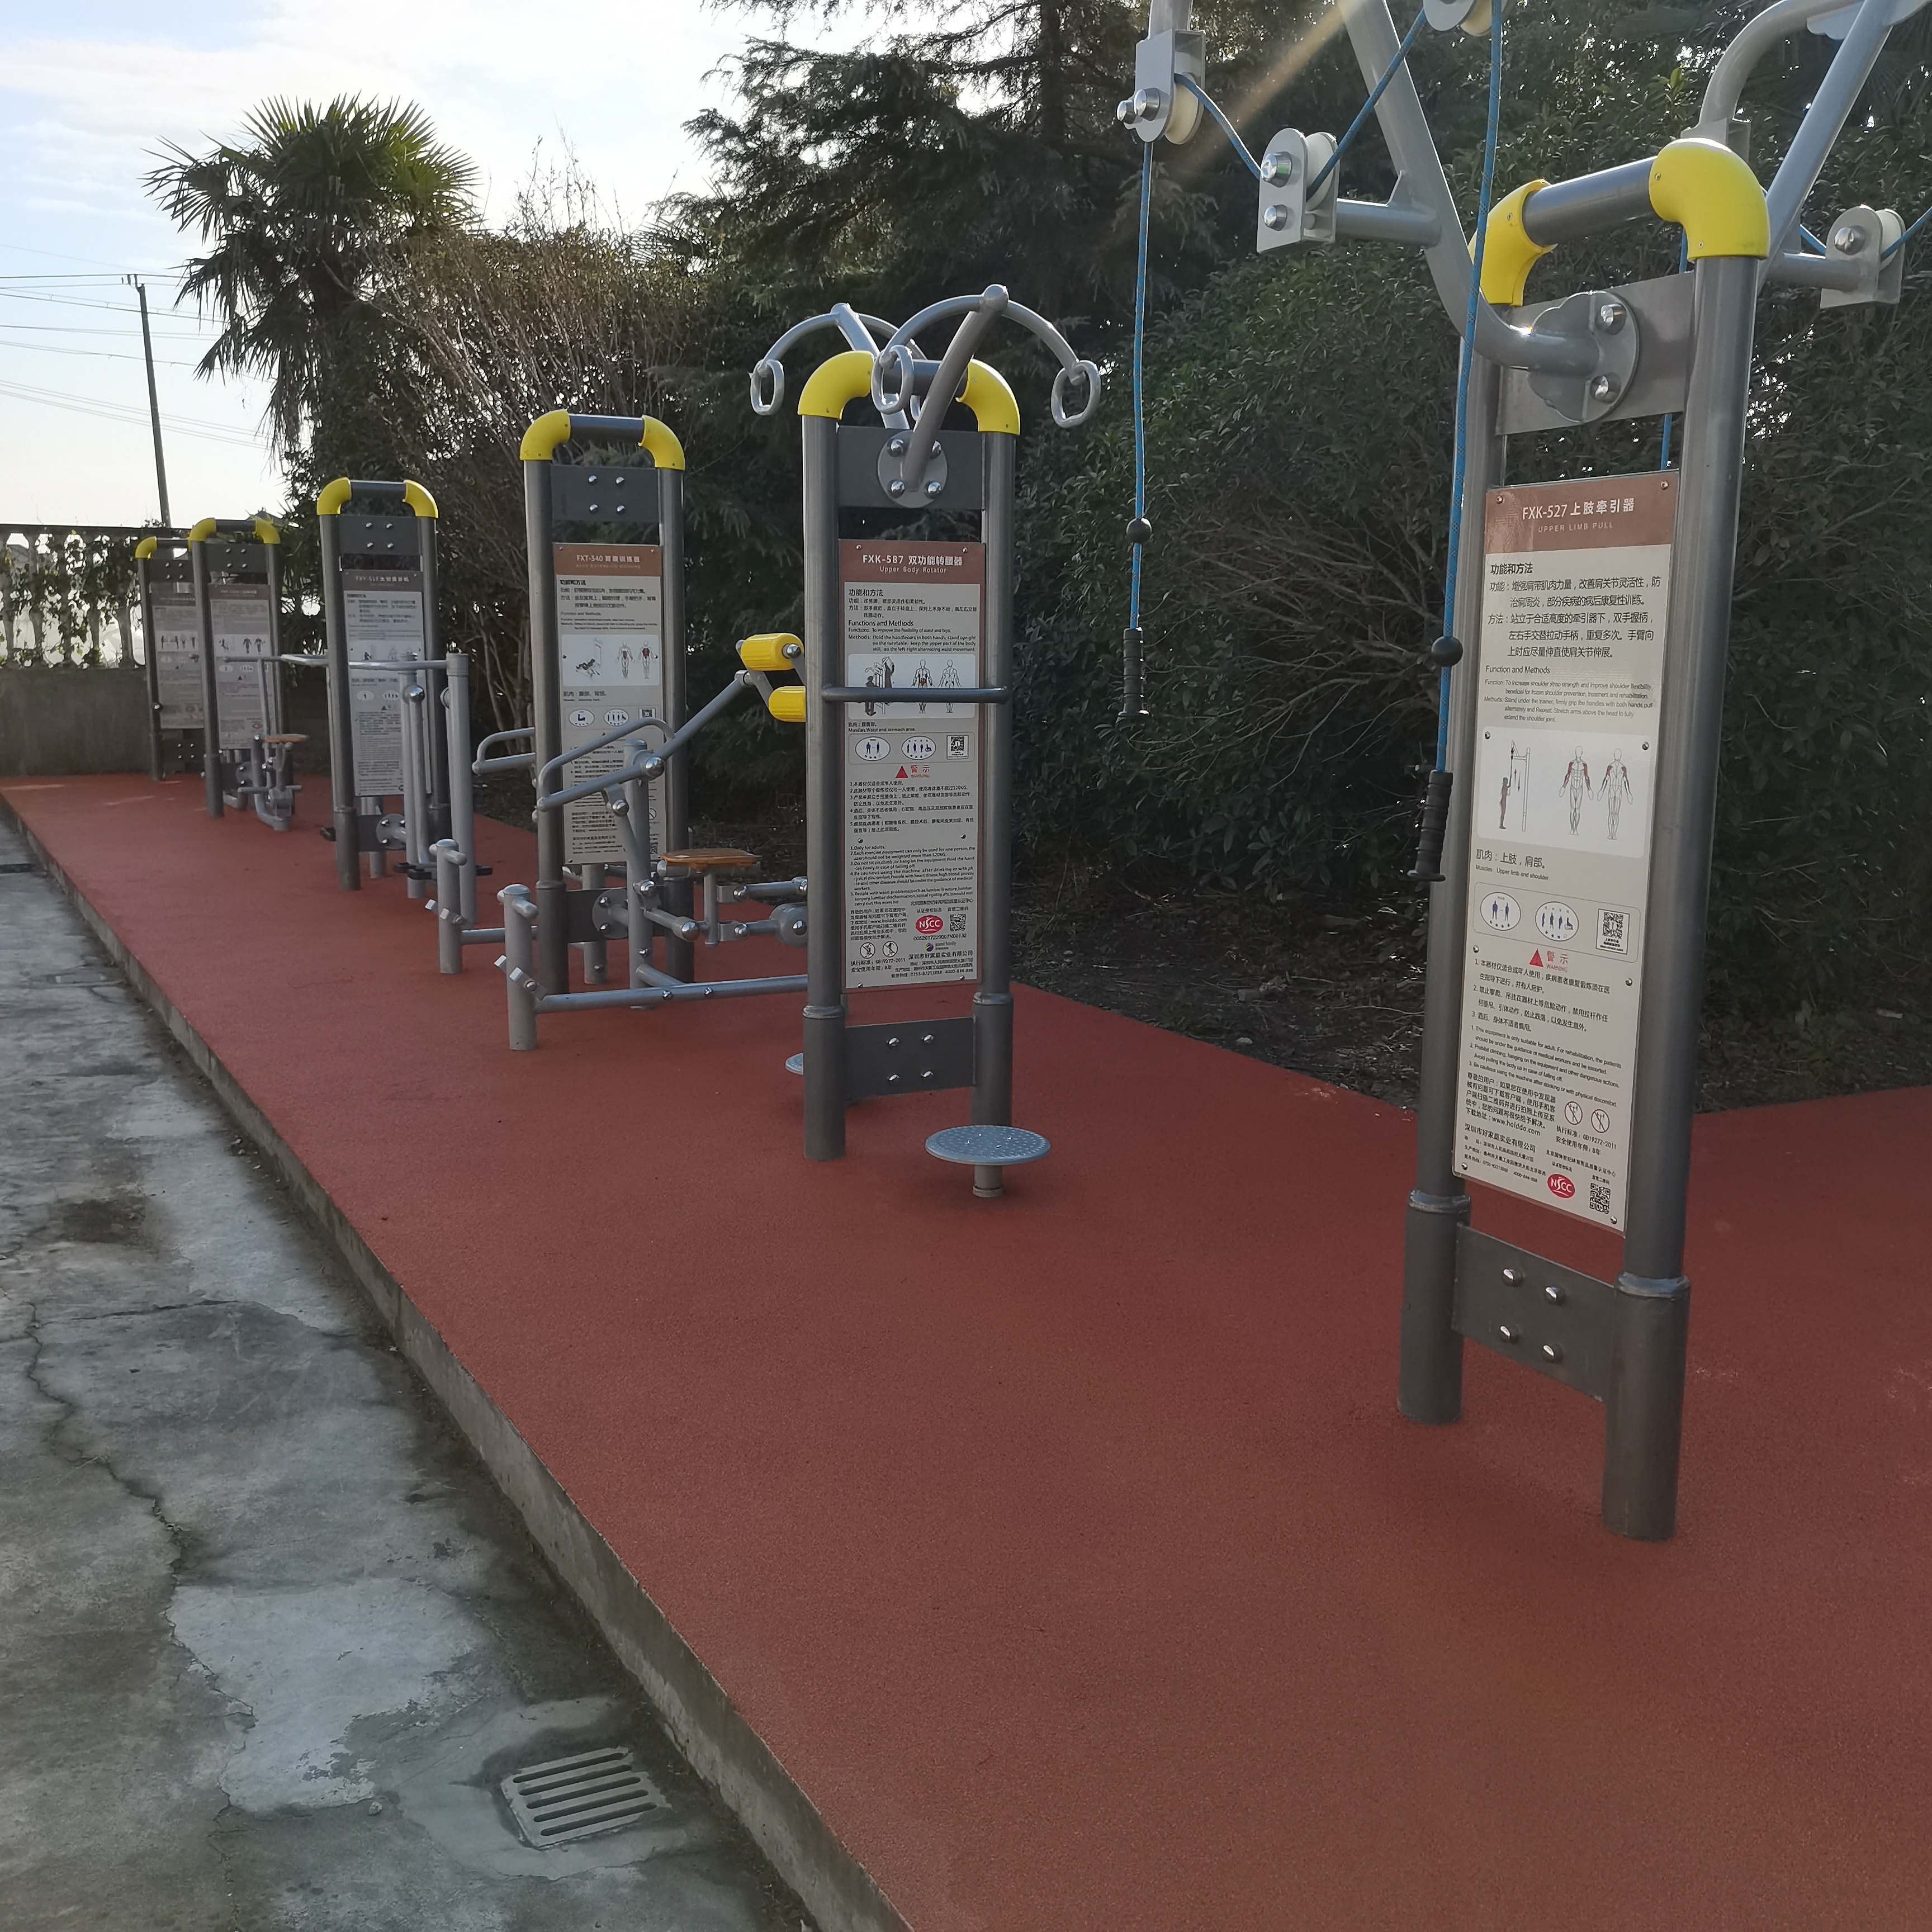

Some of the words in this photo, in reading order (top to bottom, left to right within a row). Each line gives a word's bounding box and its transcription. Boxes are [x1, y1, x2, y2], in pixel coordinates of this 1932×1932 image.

[1522, 503, 1567, 520] FXK-527
[1570, 496, 1634, 517] 上肢牵引器
[1538, 524, 1564, 533] UPPER
[1569, 523, 1588, 531] LIMB
[1592, 521, 1613, 529] PULL
[863, 554, 903, 564] FXK-587
[908, 555, 962, 566] 双功能转腰器
[903, 566, 918, 574] Body
[1490, 562, 1533, 575] 功能和方法
[849, 588, 883, 596] 功能和方法
